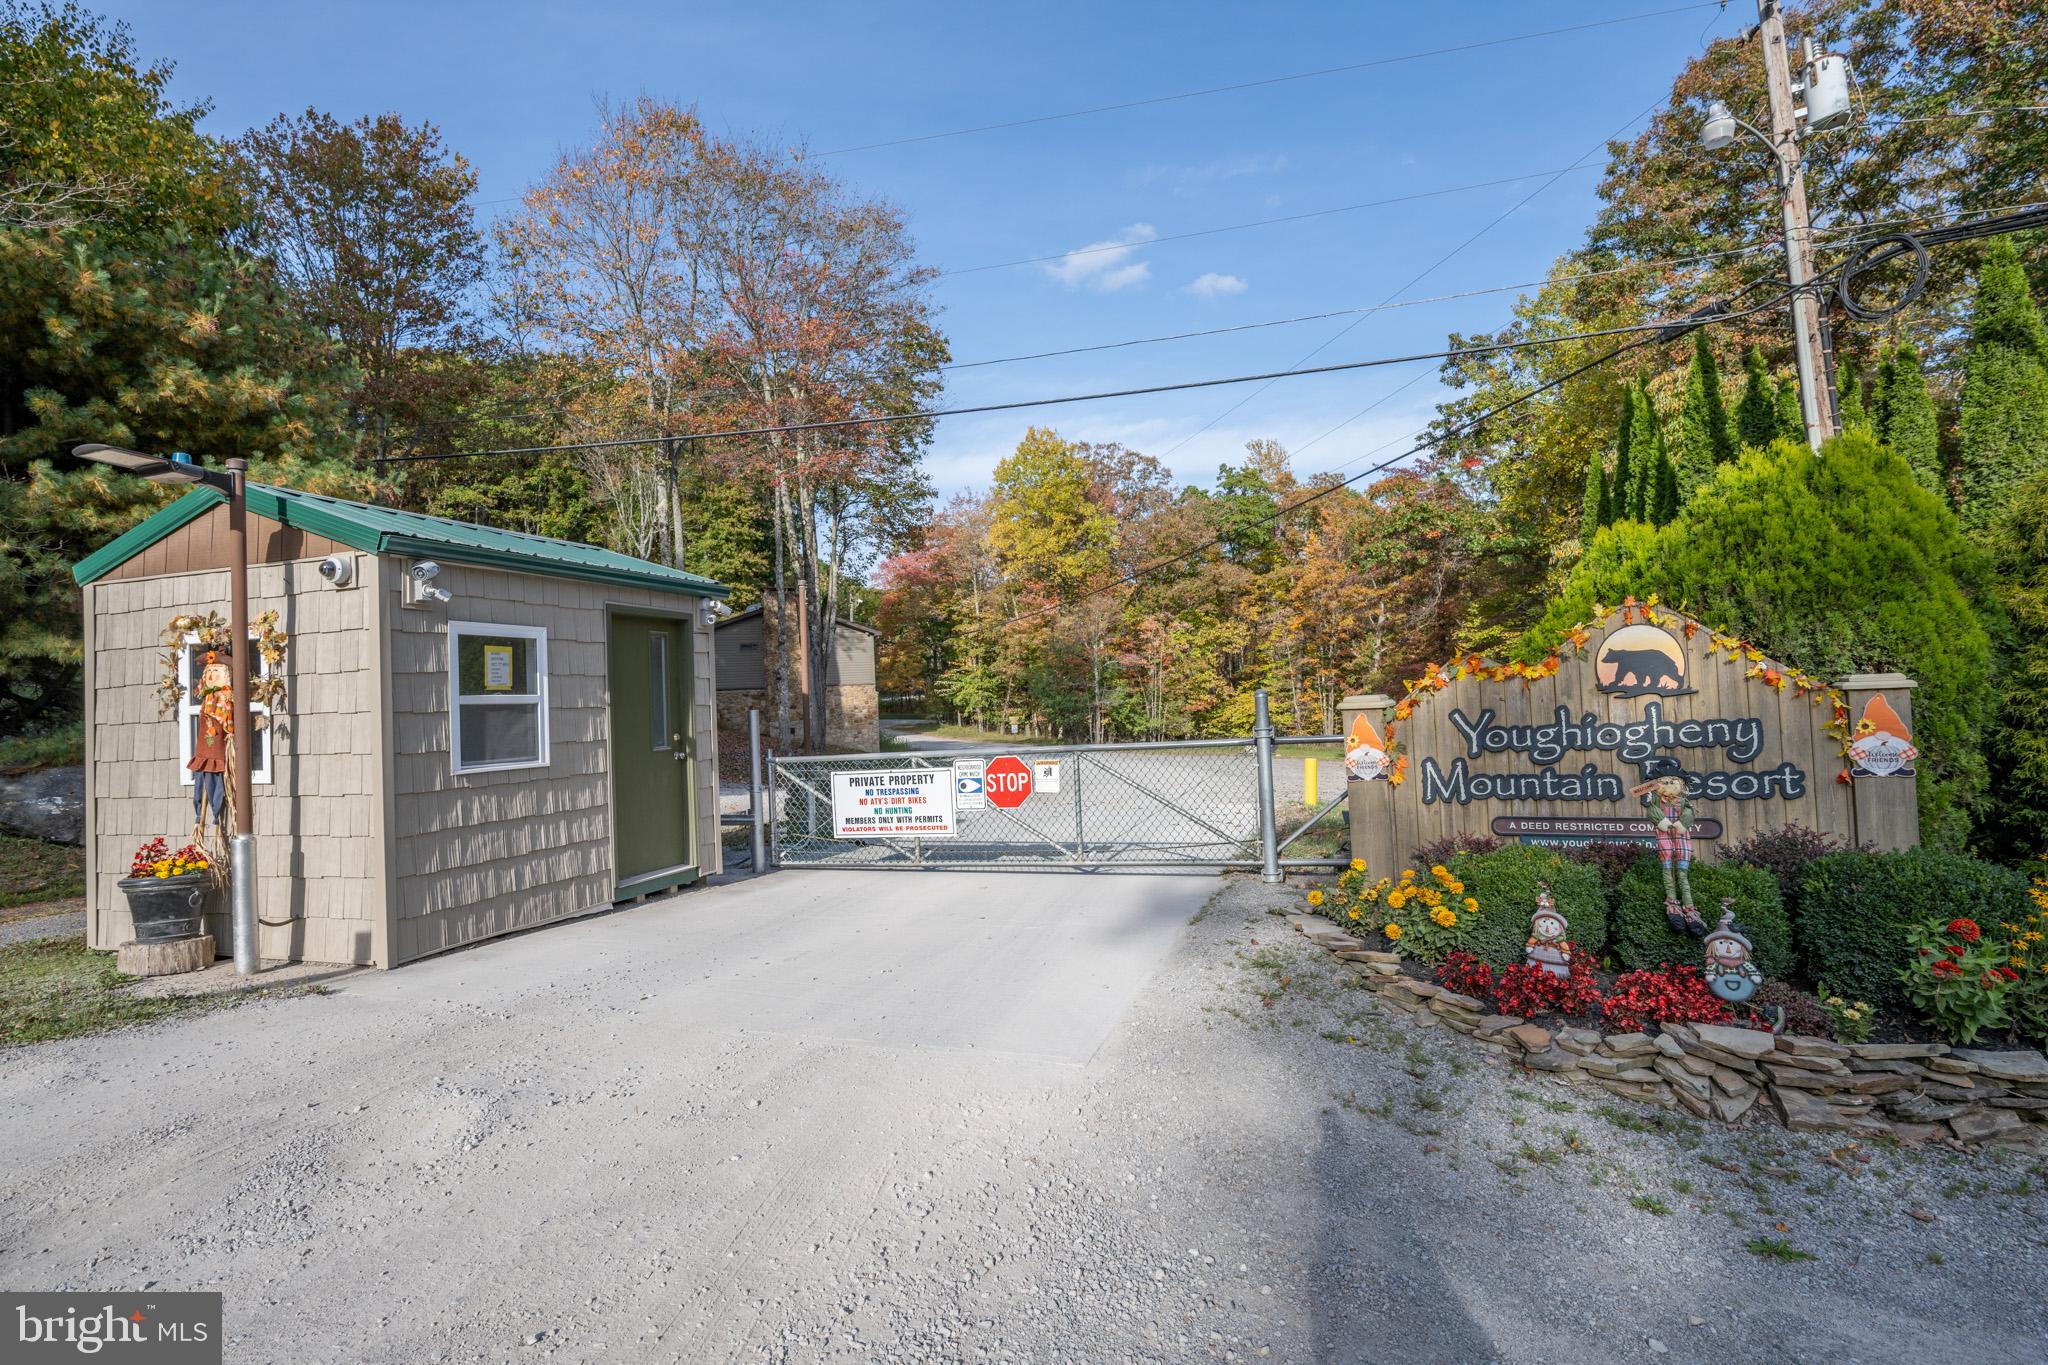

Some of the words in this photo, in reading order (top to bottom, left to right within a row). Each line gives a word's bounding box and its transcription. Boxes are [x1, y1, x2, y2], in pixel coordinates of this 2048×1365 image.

[1453, 705, 1758, 760] Youghiogheny
[849, 776, 885, 787] PRIVATE
[889, 774, 935, 786] PROPERTY
[987, 773, 1028, 792] STOP
[1426, 761, 1618, 800] Mountain
[876, 787, 920, 796] TRESPASSING
[859, 798, 868, 806] NO
[870, 797, 889, 805] ATV'S
[891, 797, 905, 805] DIRT
[908, 796, 927, 804] BIKES
[874, 807, 883, 815] NO
[885, 806, 913, 814] HUNTING
[845, 817, 876, 825] MEMBERS
[878, 816, 894, 824] ONLY
[915, 815, 943, 823] PERMITS
[1509, 822, 1517, 830] A
[1520, 822, 1550, 830] DEED
[1555, 822, 1624, 832] RESTRICTED
[1630, 823, 1702, 832] COMTY
